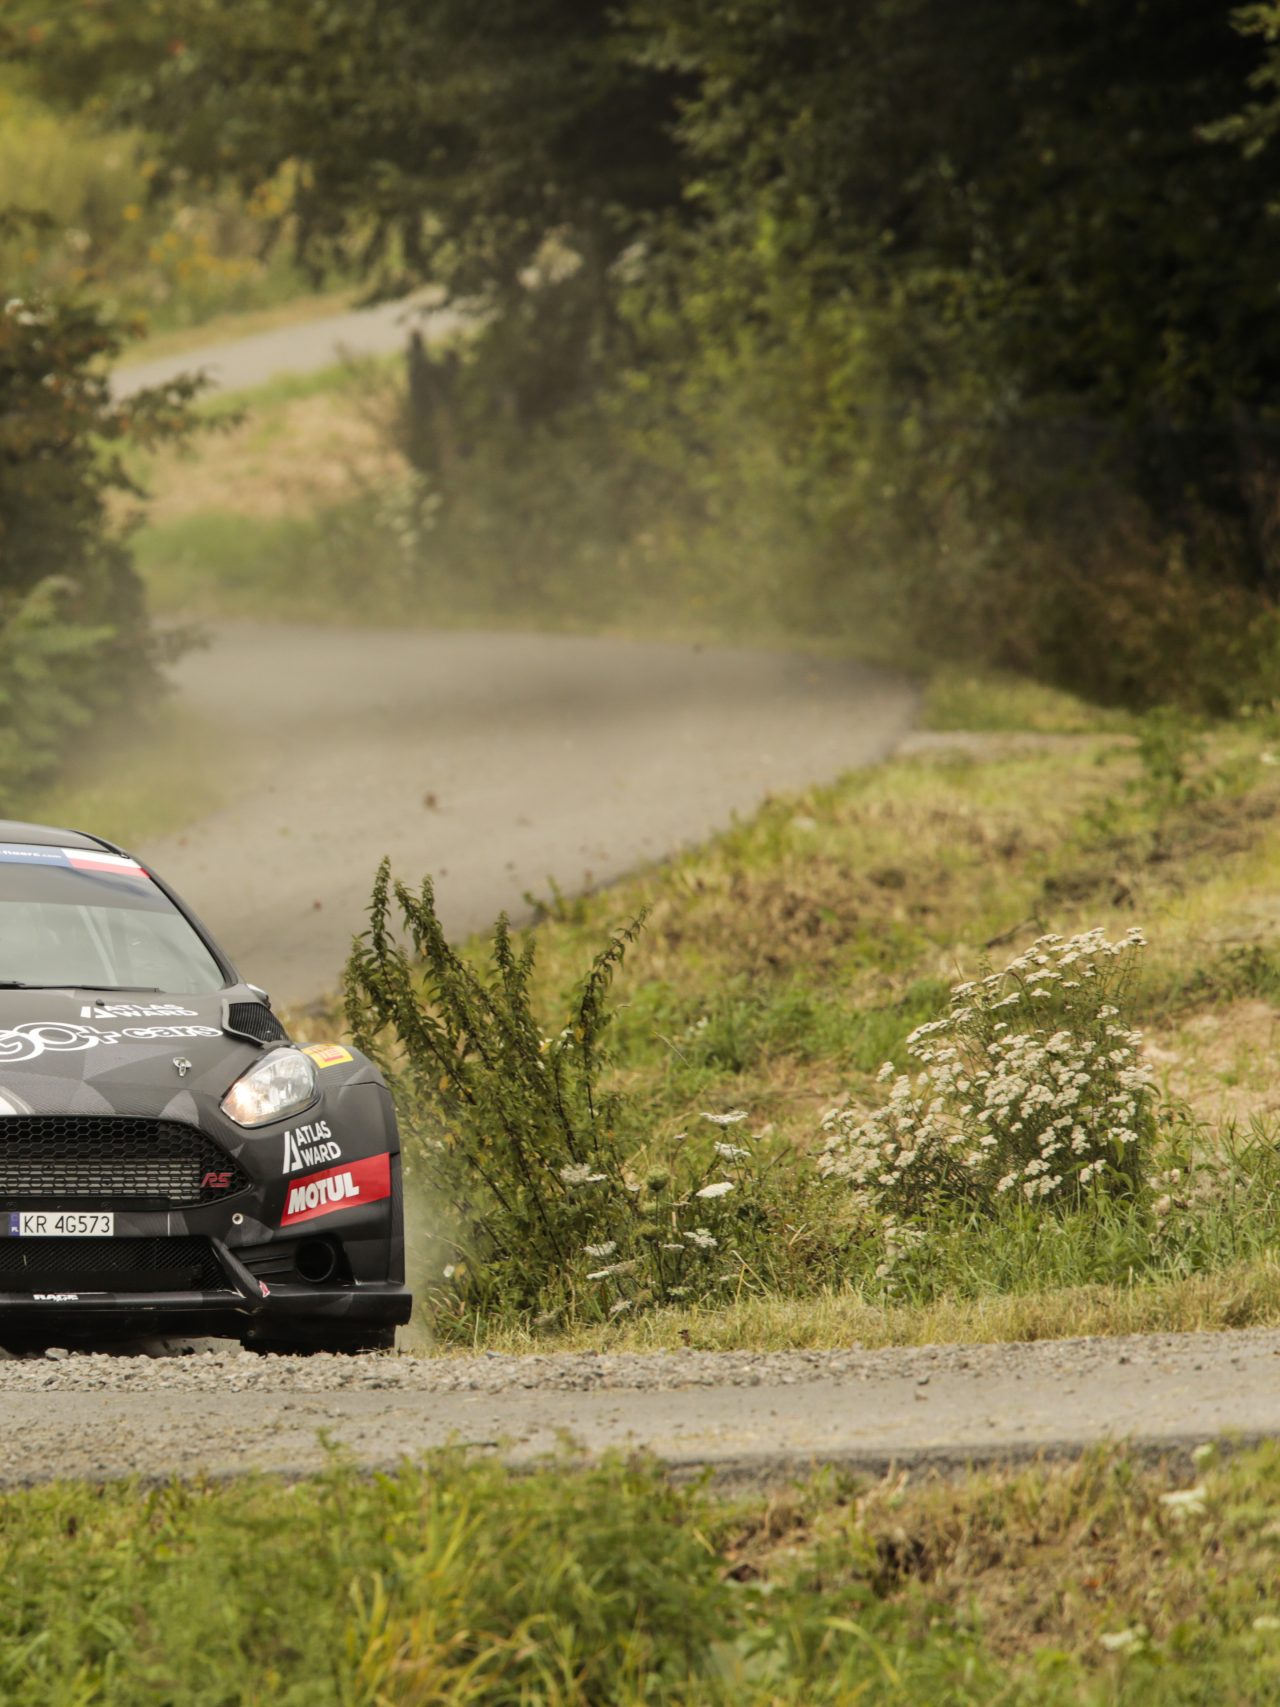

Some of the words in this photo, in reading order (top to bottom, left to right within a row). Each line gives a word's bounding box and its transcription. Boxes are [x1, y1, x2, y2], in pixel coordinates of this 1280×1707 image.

[295, 1120, 332, 1147] ATLAS
[300, 1141, 342, 1167] WARD
[200, 1172, 234, 1188] RS
[287, 1171, 360, 1215] MOTUL
[24, 1215, 48, 1234] KR
[55, 1215, 111, 1234] 4G573
